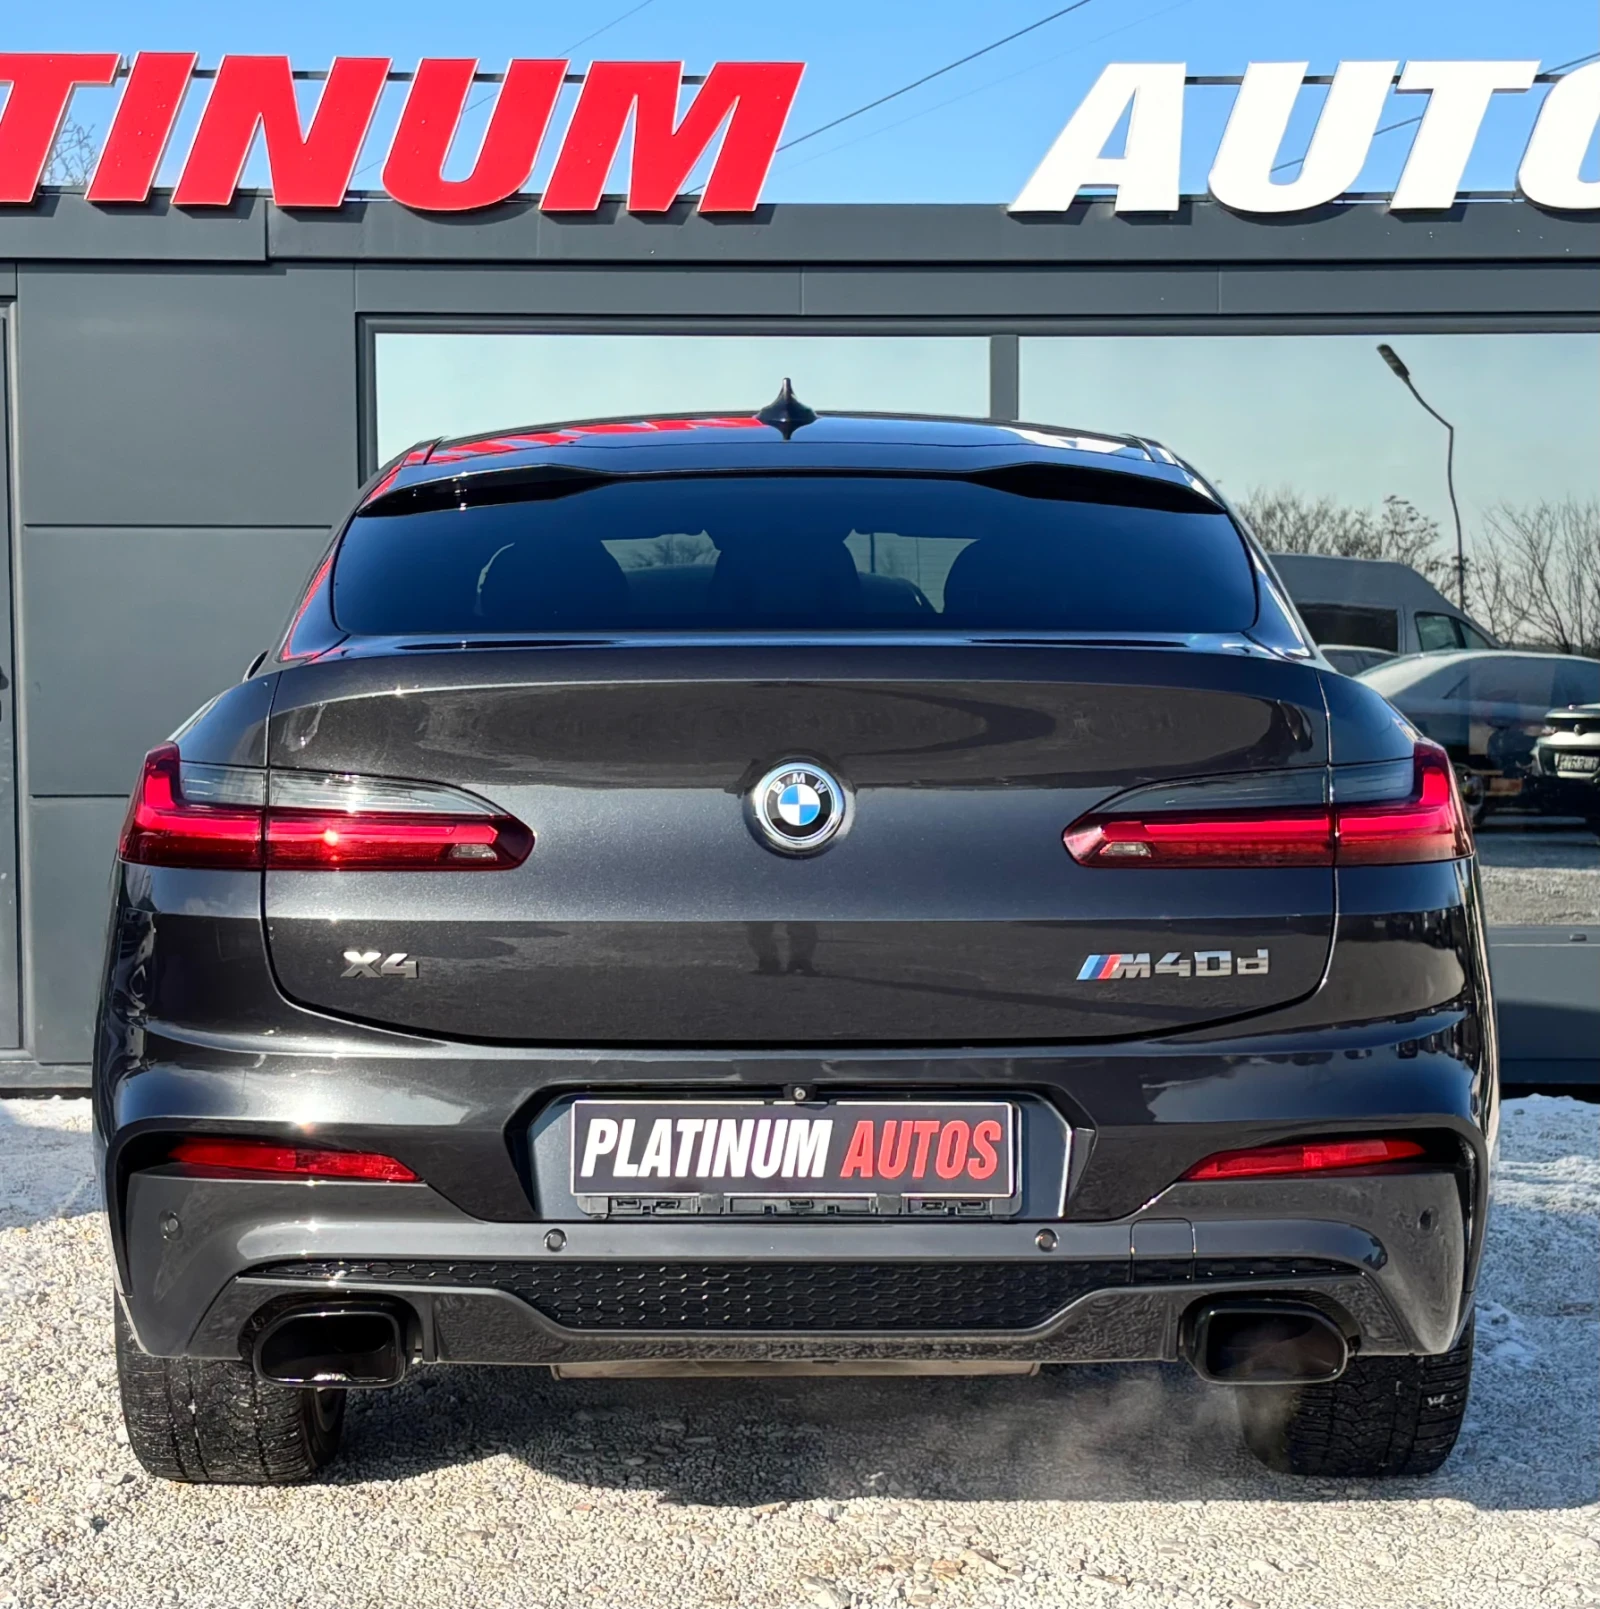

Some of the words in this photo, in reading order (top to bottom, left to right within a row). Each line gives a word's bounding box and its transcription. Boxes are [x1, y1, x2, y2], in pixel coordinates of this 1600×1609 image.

[0, 51, 807, 213] TINUM
[771, 772, 828, 795] BMW
[340, 951, 418, 979] X4
[580, 1118, 834, 1179] PLATINUM
[839, 1119, 1002, 1180] AUTOS
